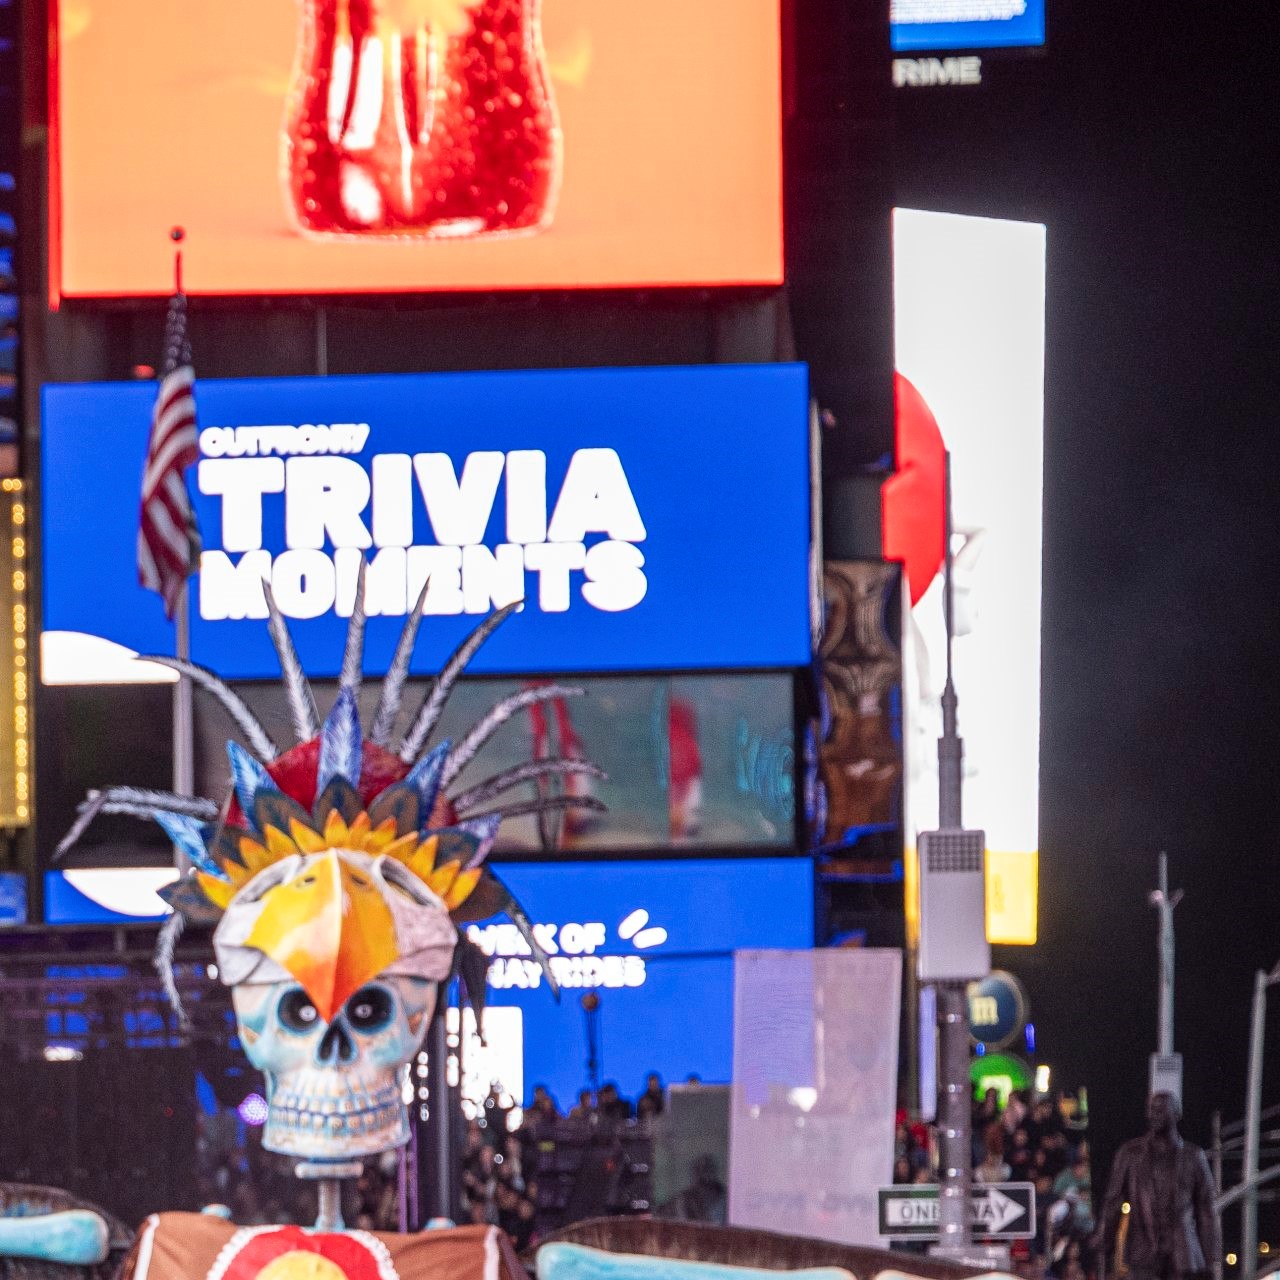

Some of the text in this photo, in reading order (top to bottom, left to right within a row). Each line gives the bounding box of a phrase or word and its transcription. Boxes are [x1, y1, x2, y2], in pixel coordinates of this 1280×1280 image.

[892, 56, 982, 88] RIME
[198, 447, 648, 552] TRIVIA
[199, 540, 648, 620] MOMENTS
[559, 922, 606, 955] OF
